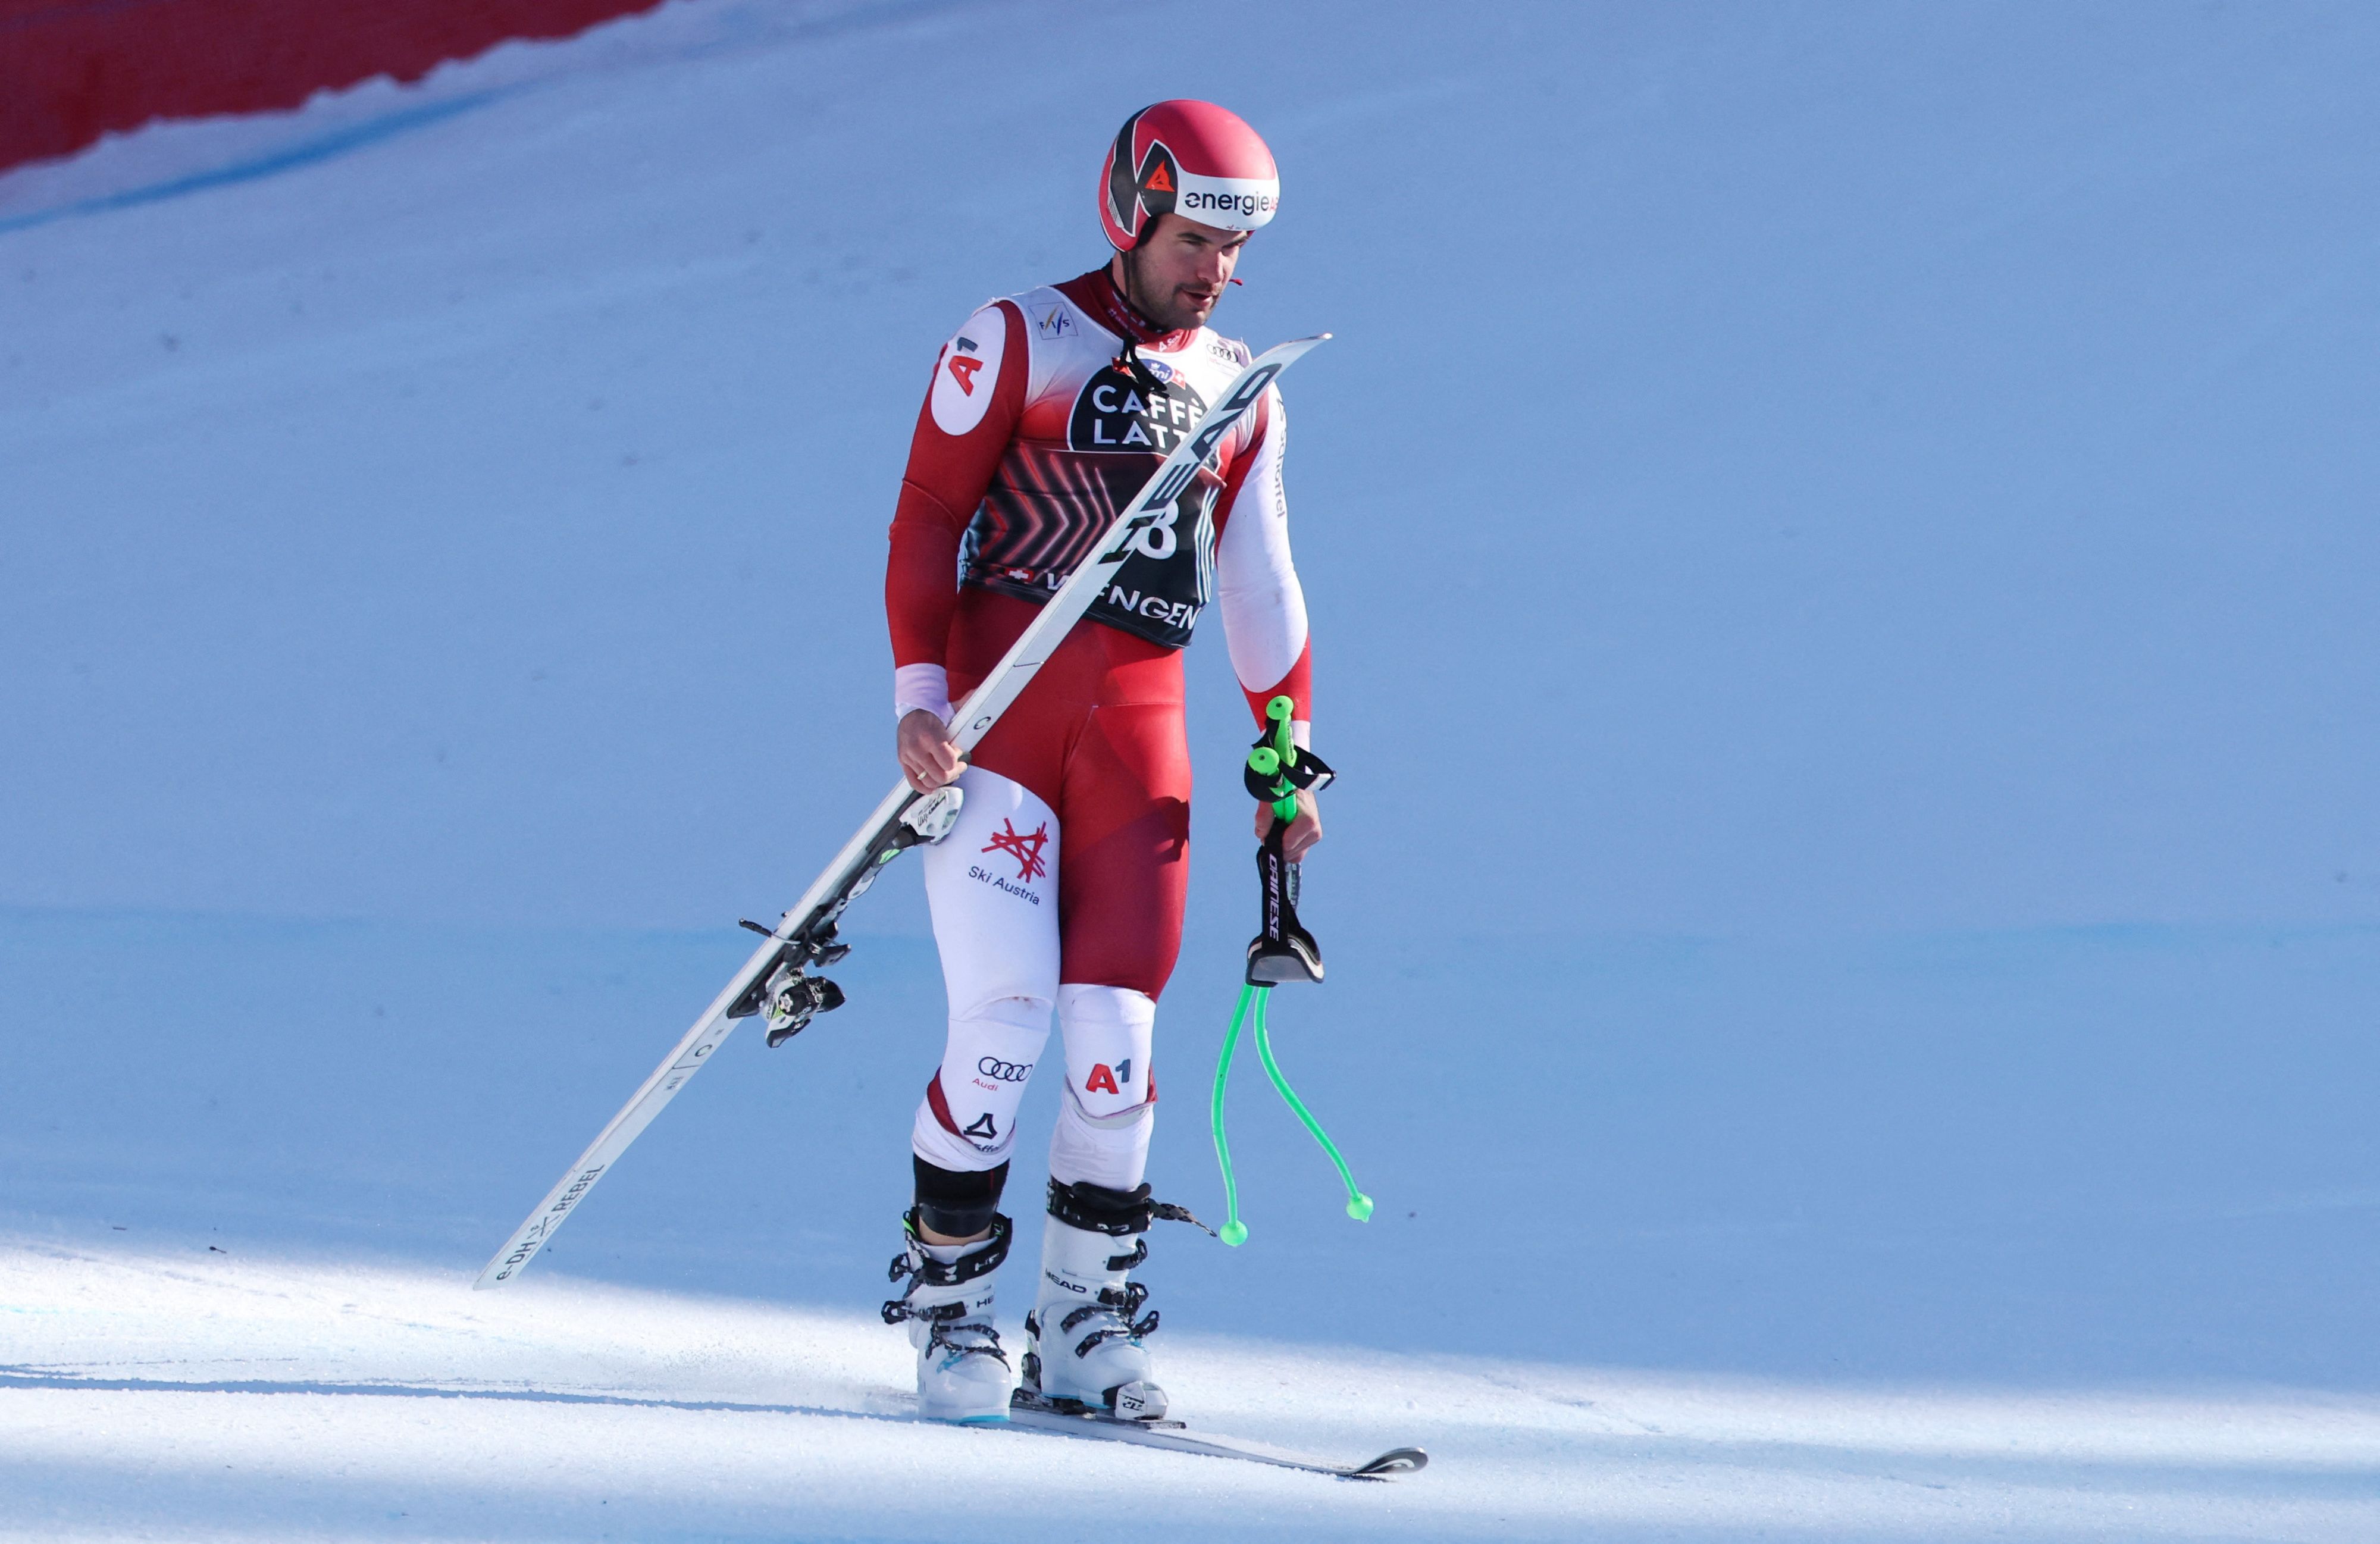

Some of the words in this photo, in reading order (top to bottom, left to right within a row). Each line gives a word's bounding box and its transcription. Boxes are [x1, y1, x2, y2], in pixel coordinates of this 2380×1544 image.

[948, 337, 984, 397] A1
[1094, 419, 1189, 449] LATT
[1098, 363, 1282, 565] HEAD
[969, 866, 992, 883] Ski
[992, 878, 1040, 906] Austria
[1269, 853, 1279, 941] DAINESE
[972, 1078, 998, 1091] Audi
[1085, 1059, 1130, 1095] A1
[496, 1241, 537, 1280] e-DH
[551, 1164, 605, 1213] REBEL
[1045, 1267, 1087, 1294] HEAD
